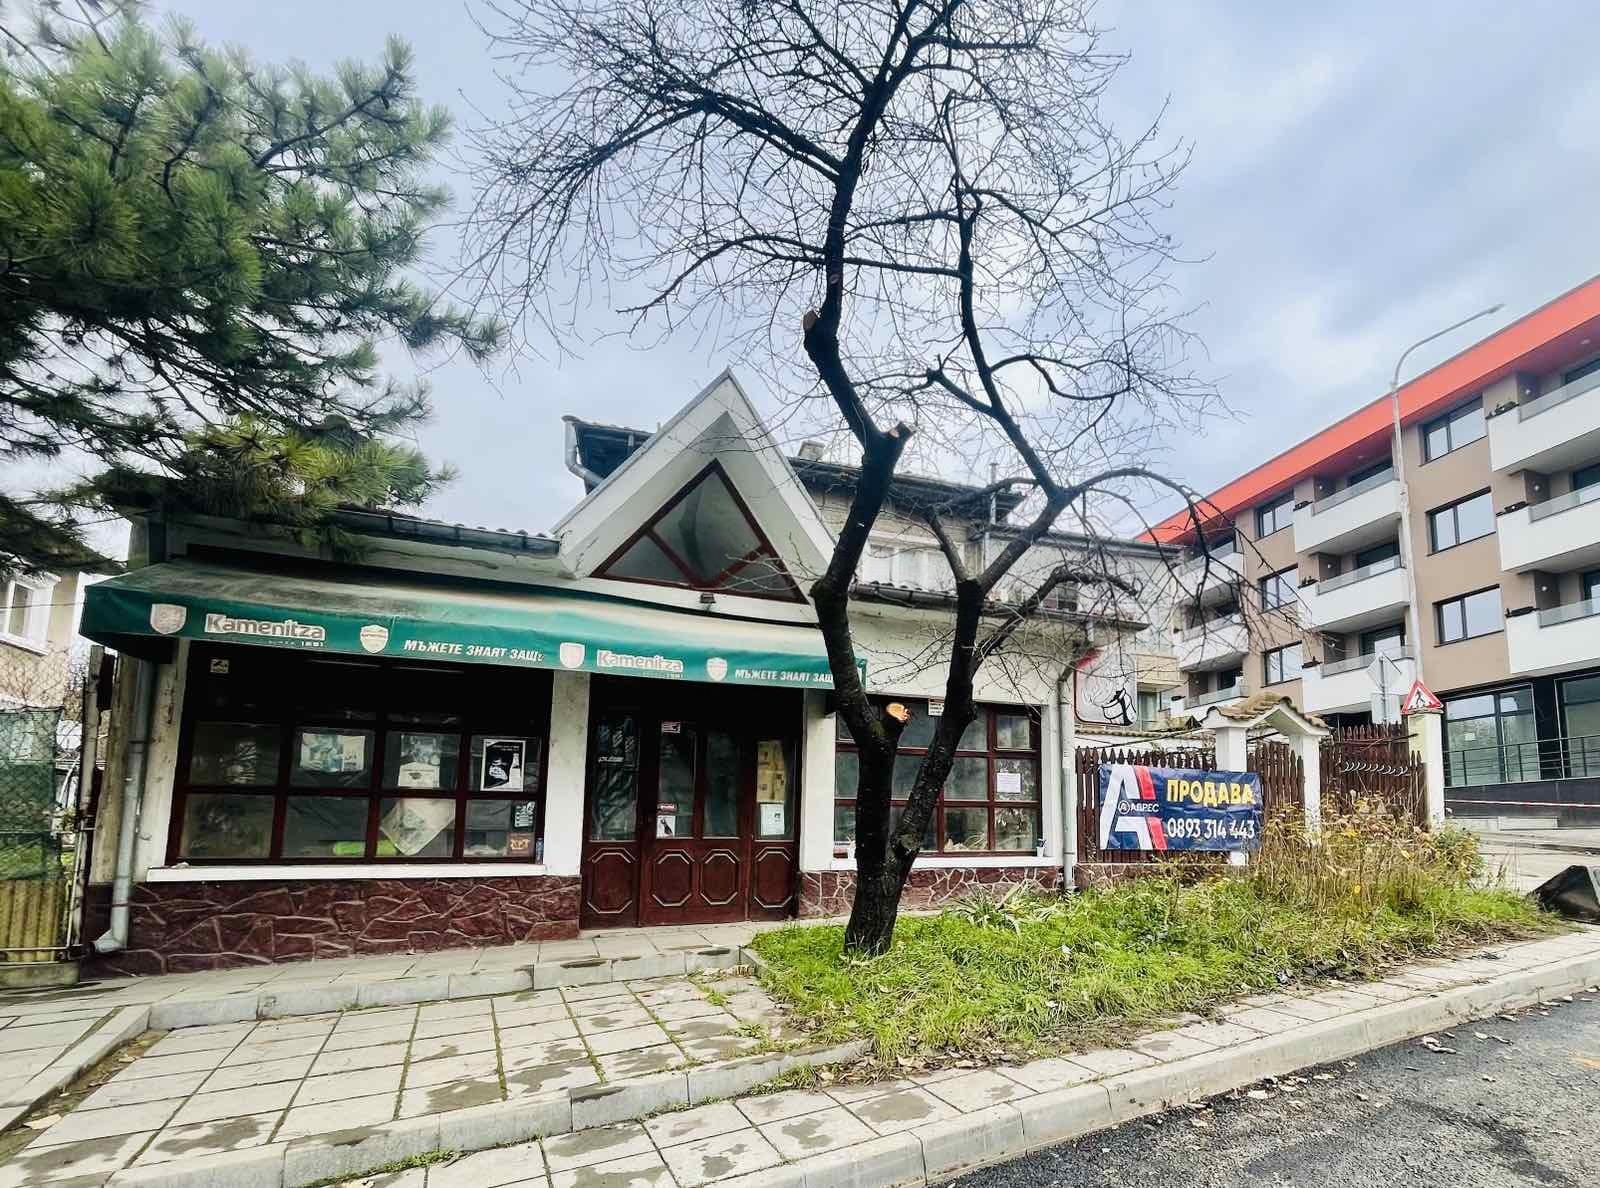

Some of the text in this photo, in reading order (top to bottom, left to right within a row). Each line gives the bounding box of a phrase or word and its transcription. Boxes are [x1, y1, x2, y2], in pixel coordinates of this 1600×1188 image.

[206, 614, 325, 640] Kamenitza
[404, 639, 464, 655] МЪЖЕТЕ
[466, 644, 508, 658] ЗНАЯТ
[597, 650, 683, 672] Kamenitza
[734, 669, 834, 684] МЪЖЕТЕ ЗНАЯТ ЗАЩ
[1167, 779, 1256, 807] ПРОДАВА
[1167, 817, 1256, 840] 0893 314 443
